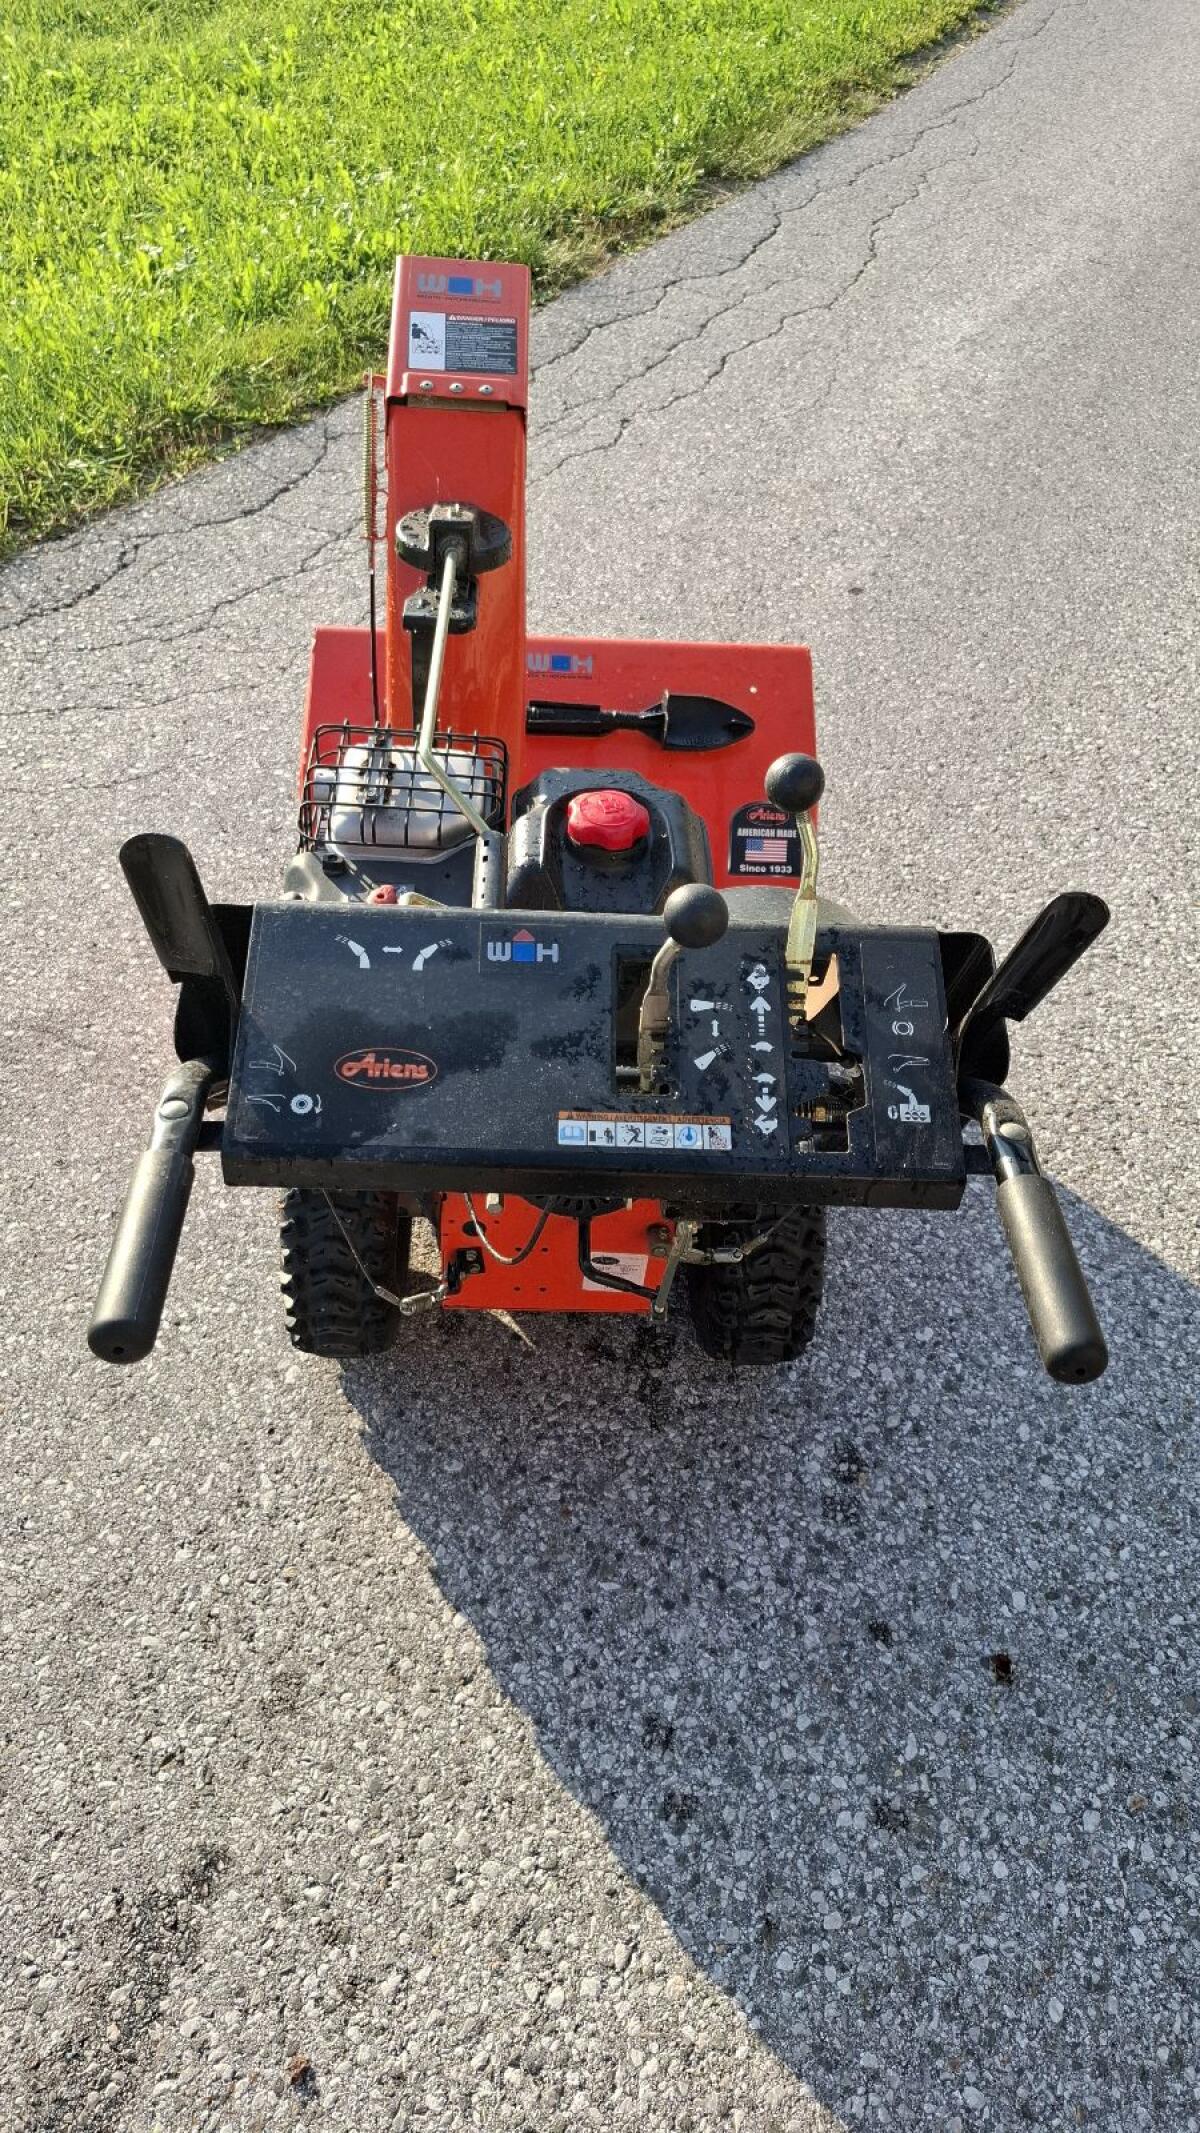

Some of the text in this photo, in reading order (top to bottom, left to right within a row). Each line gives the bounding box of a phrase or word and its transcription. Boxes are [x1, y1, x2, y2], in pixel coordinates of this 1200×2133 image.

[748, 807, 786, 821] Ariens
[737, 828, 797, 838] AMERICAN MADE
[739, 864, 793, 874] Since 1933
[341, 1053, 429, 1079] Ariens
